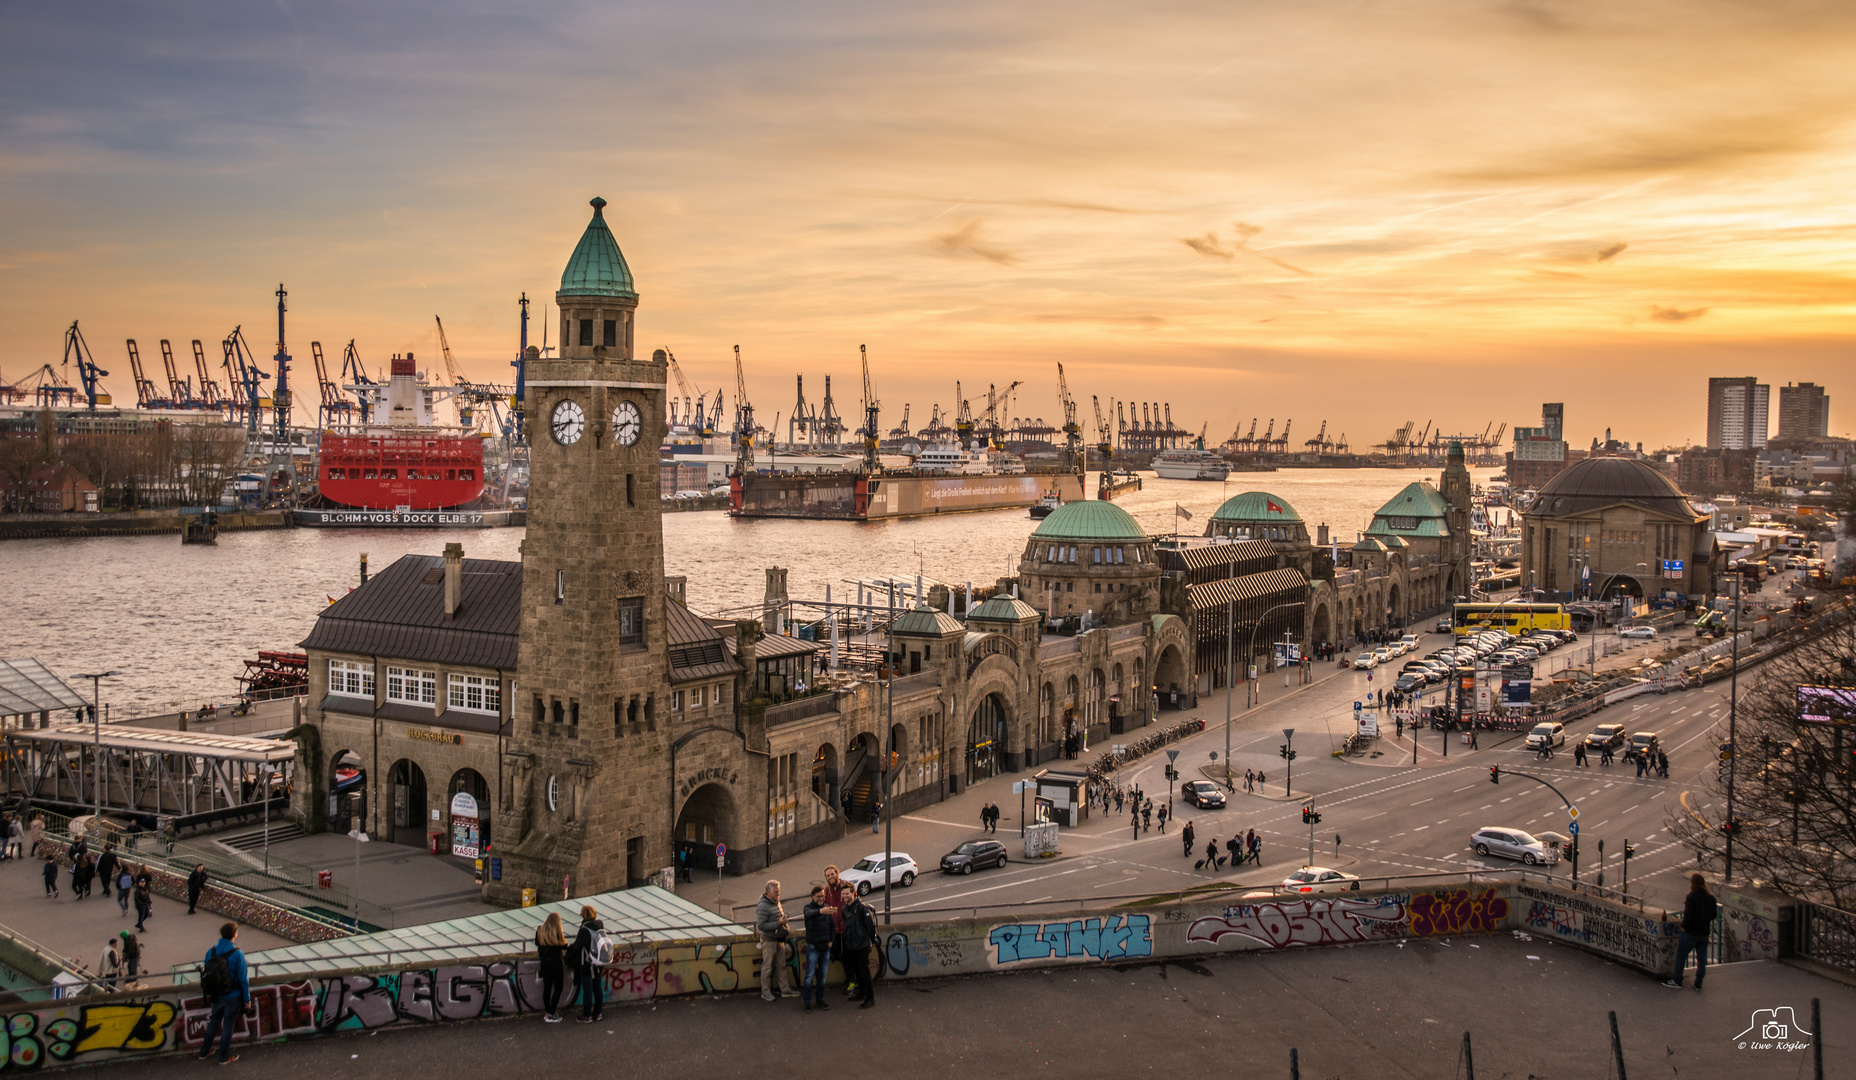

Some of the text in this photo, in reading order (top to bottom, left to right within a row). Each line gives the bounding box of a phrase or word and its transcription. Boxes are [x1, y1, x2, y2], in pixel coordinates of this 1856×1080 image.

[931, 489, 941, 499] Liegt
[403, 514, 434, 523] DOCK
[438, 514, 467, 523] ELBE
[470, 514, 483, 523] 17
[454, 845, 477, 857] KASSE
